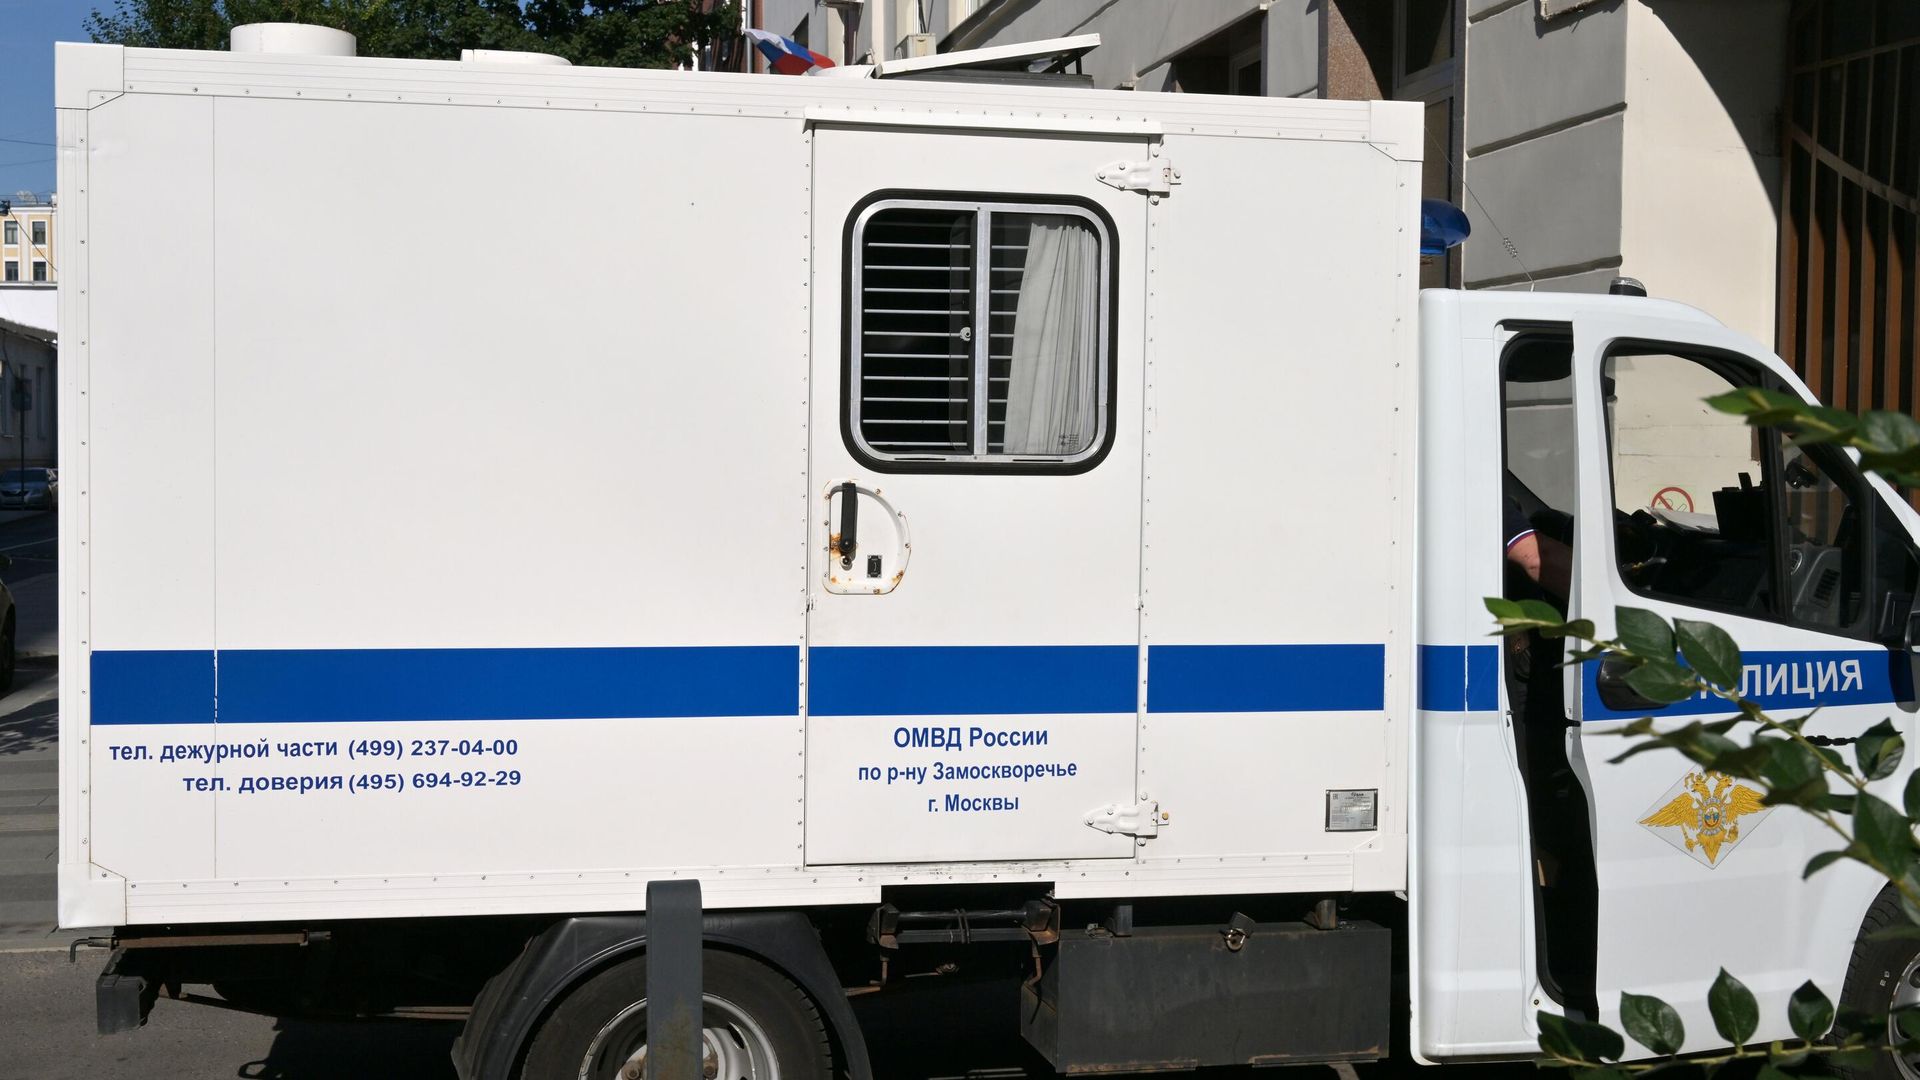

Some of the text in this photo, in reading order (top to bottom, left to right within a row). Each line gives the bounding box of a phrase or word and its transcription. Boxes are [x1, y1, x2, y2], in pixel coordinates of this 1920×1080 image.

[1685, 659, 1863, 700] ЛИЦИЯ
[110, 738, 518, 764] тел. дежурной части (499) 237-04-00
[893, 727, 1048, 751] ОМВД России
[183, 770, 521, 795] тел. доверия (495) 694-92-29
[858, 761, 1077, 785] по р-ну Замоскворечье
[928, 793, 1019, 812] г. Москвы
